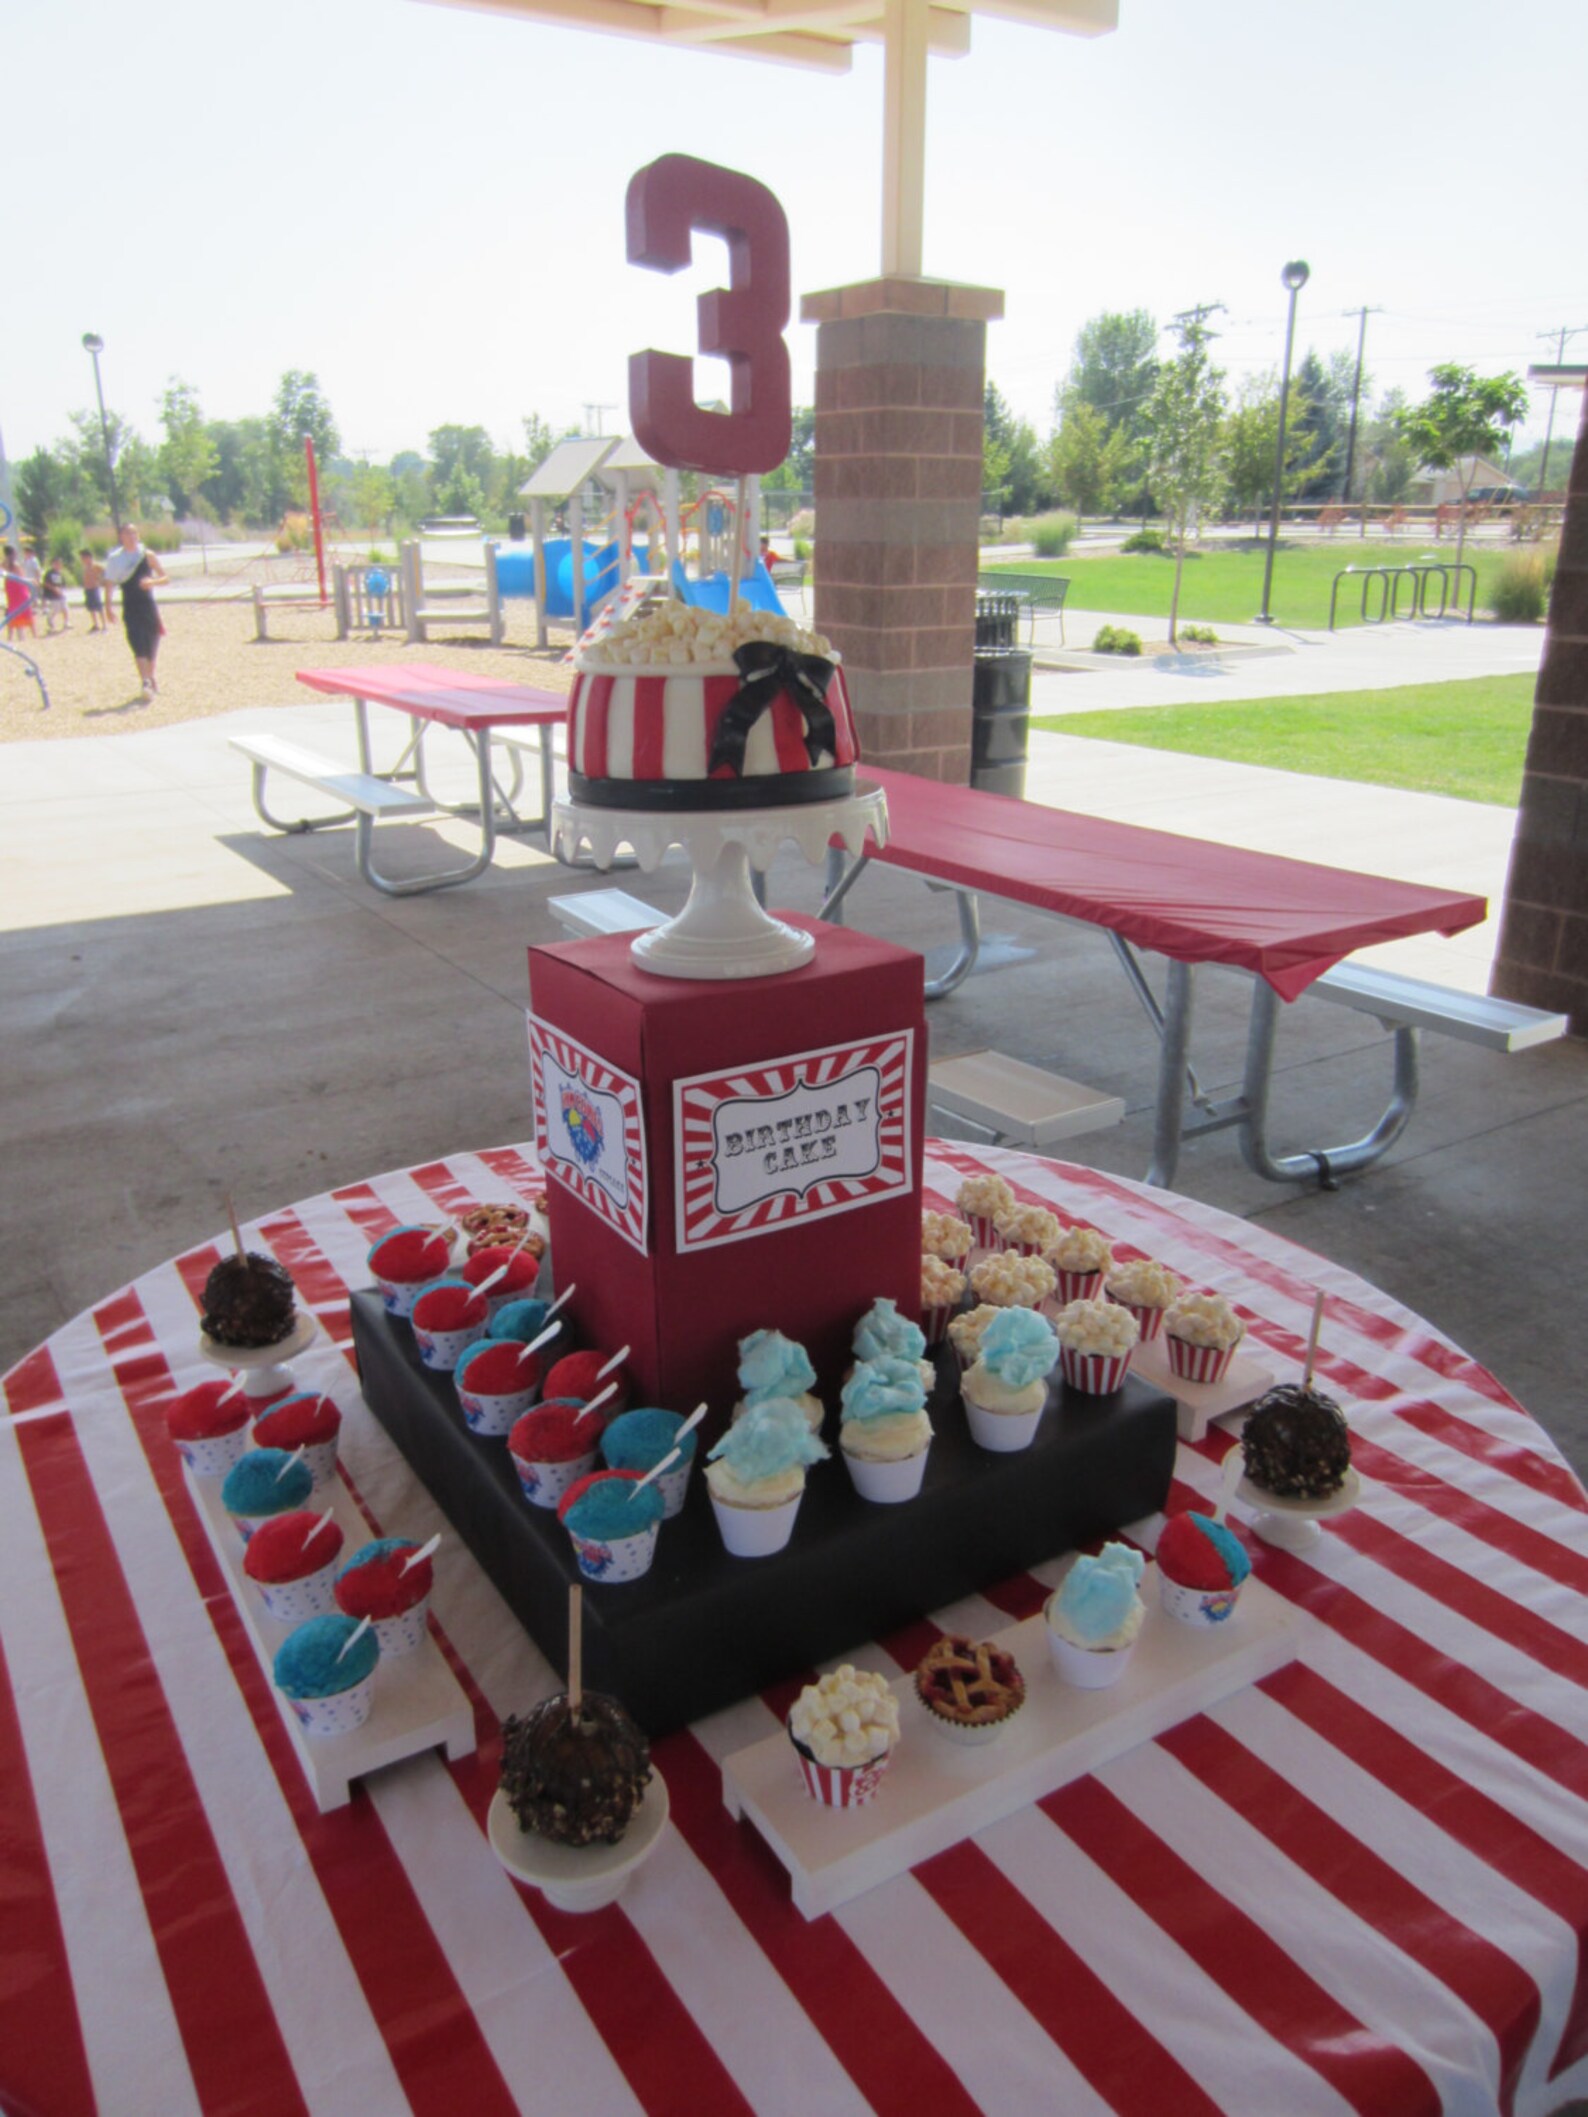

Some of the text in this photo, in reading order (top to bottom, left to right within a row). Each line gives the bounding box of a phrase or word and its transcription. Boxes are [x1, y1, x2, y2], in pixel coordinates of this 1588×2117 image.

[625, 152, 792, 479] 3
[725, 1098, 871, 1158] BIRTHDAY
[764, 1135, 837, 1175] CAKE
